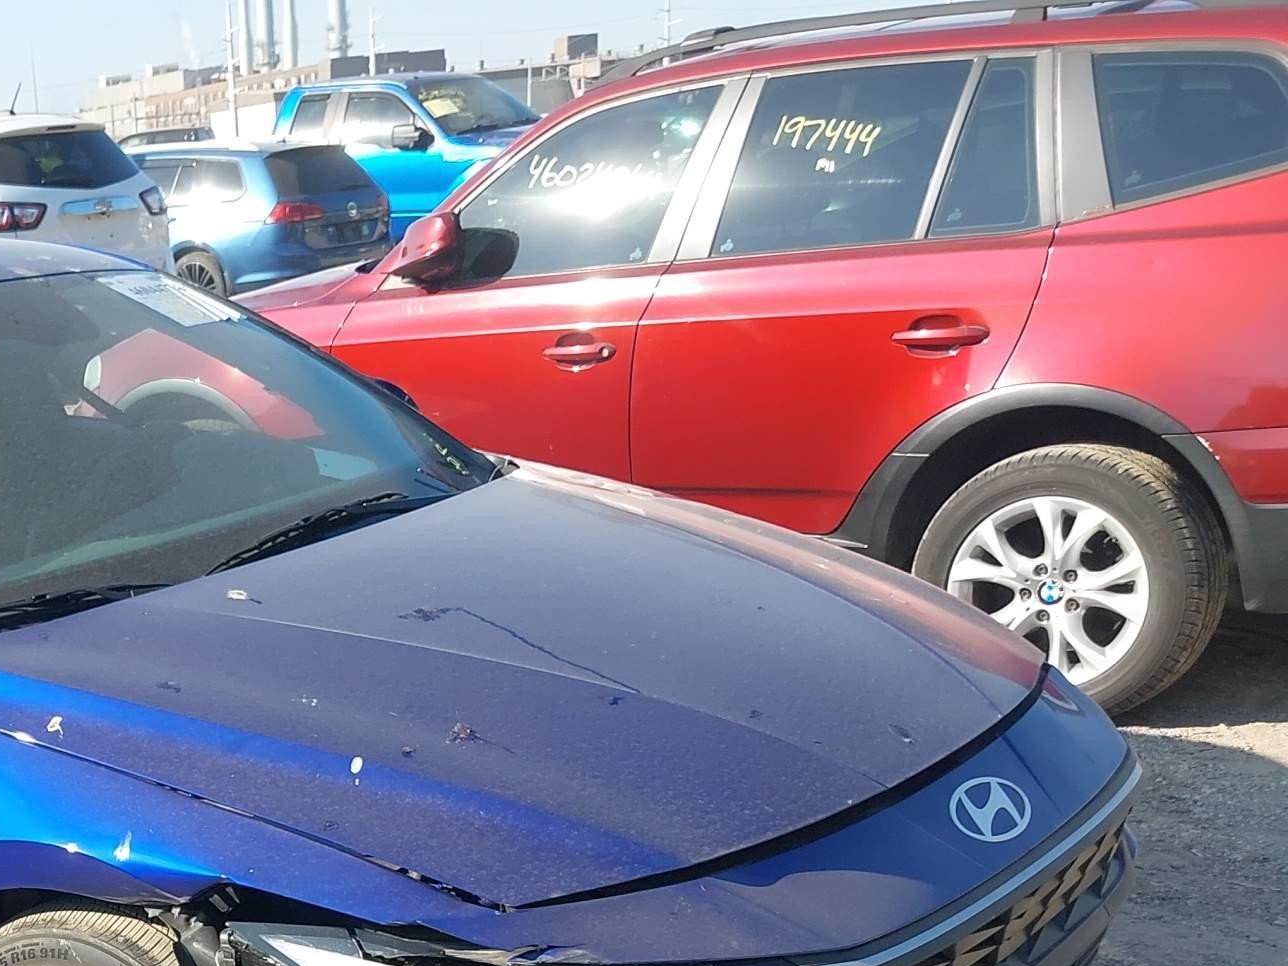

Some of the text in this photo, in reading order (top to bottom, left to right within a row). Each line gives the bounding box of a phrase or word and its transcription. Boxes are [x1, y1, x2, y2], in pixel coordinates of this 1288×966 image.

[772, 115, 881, 157] 197444
[11, 948, 37, 964] R16
[39, 947, 69, 961] 91H
